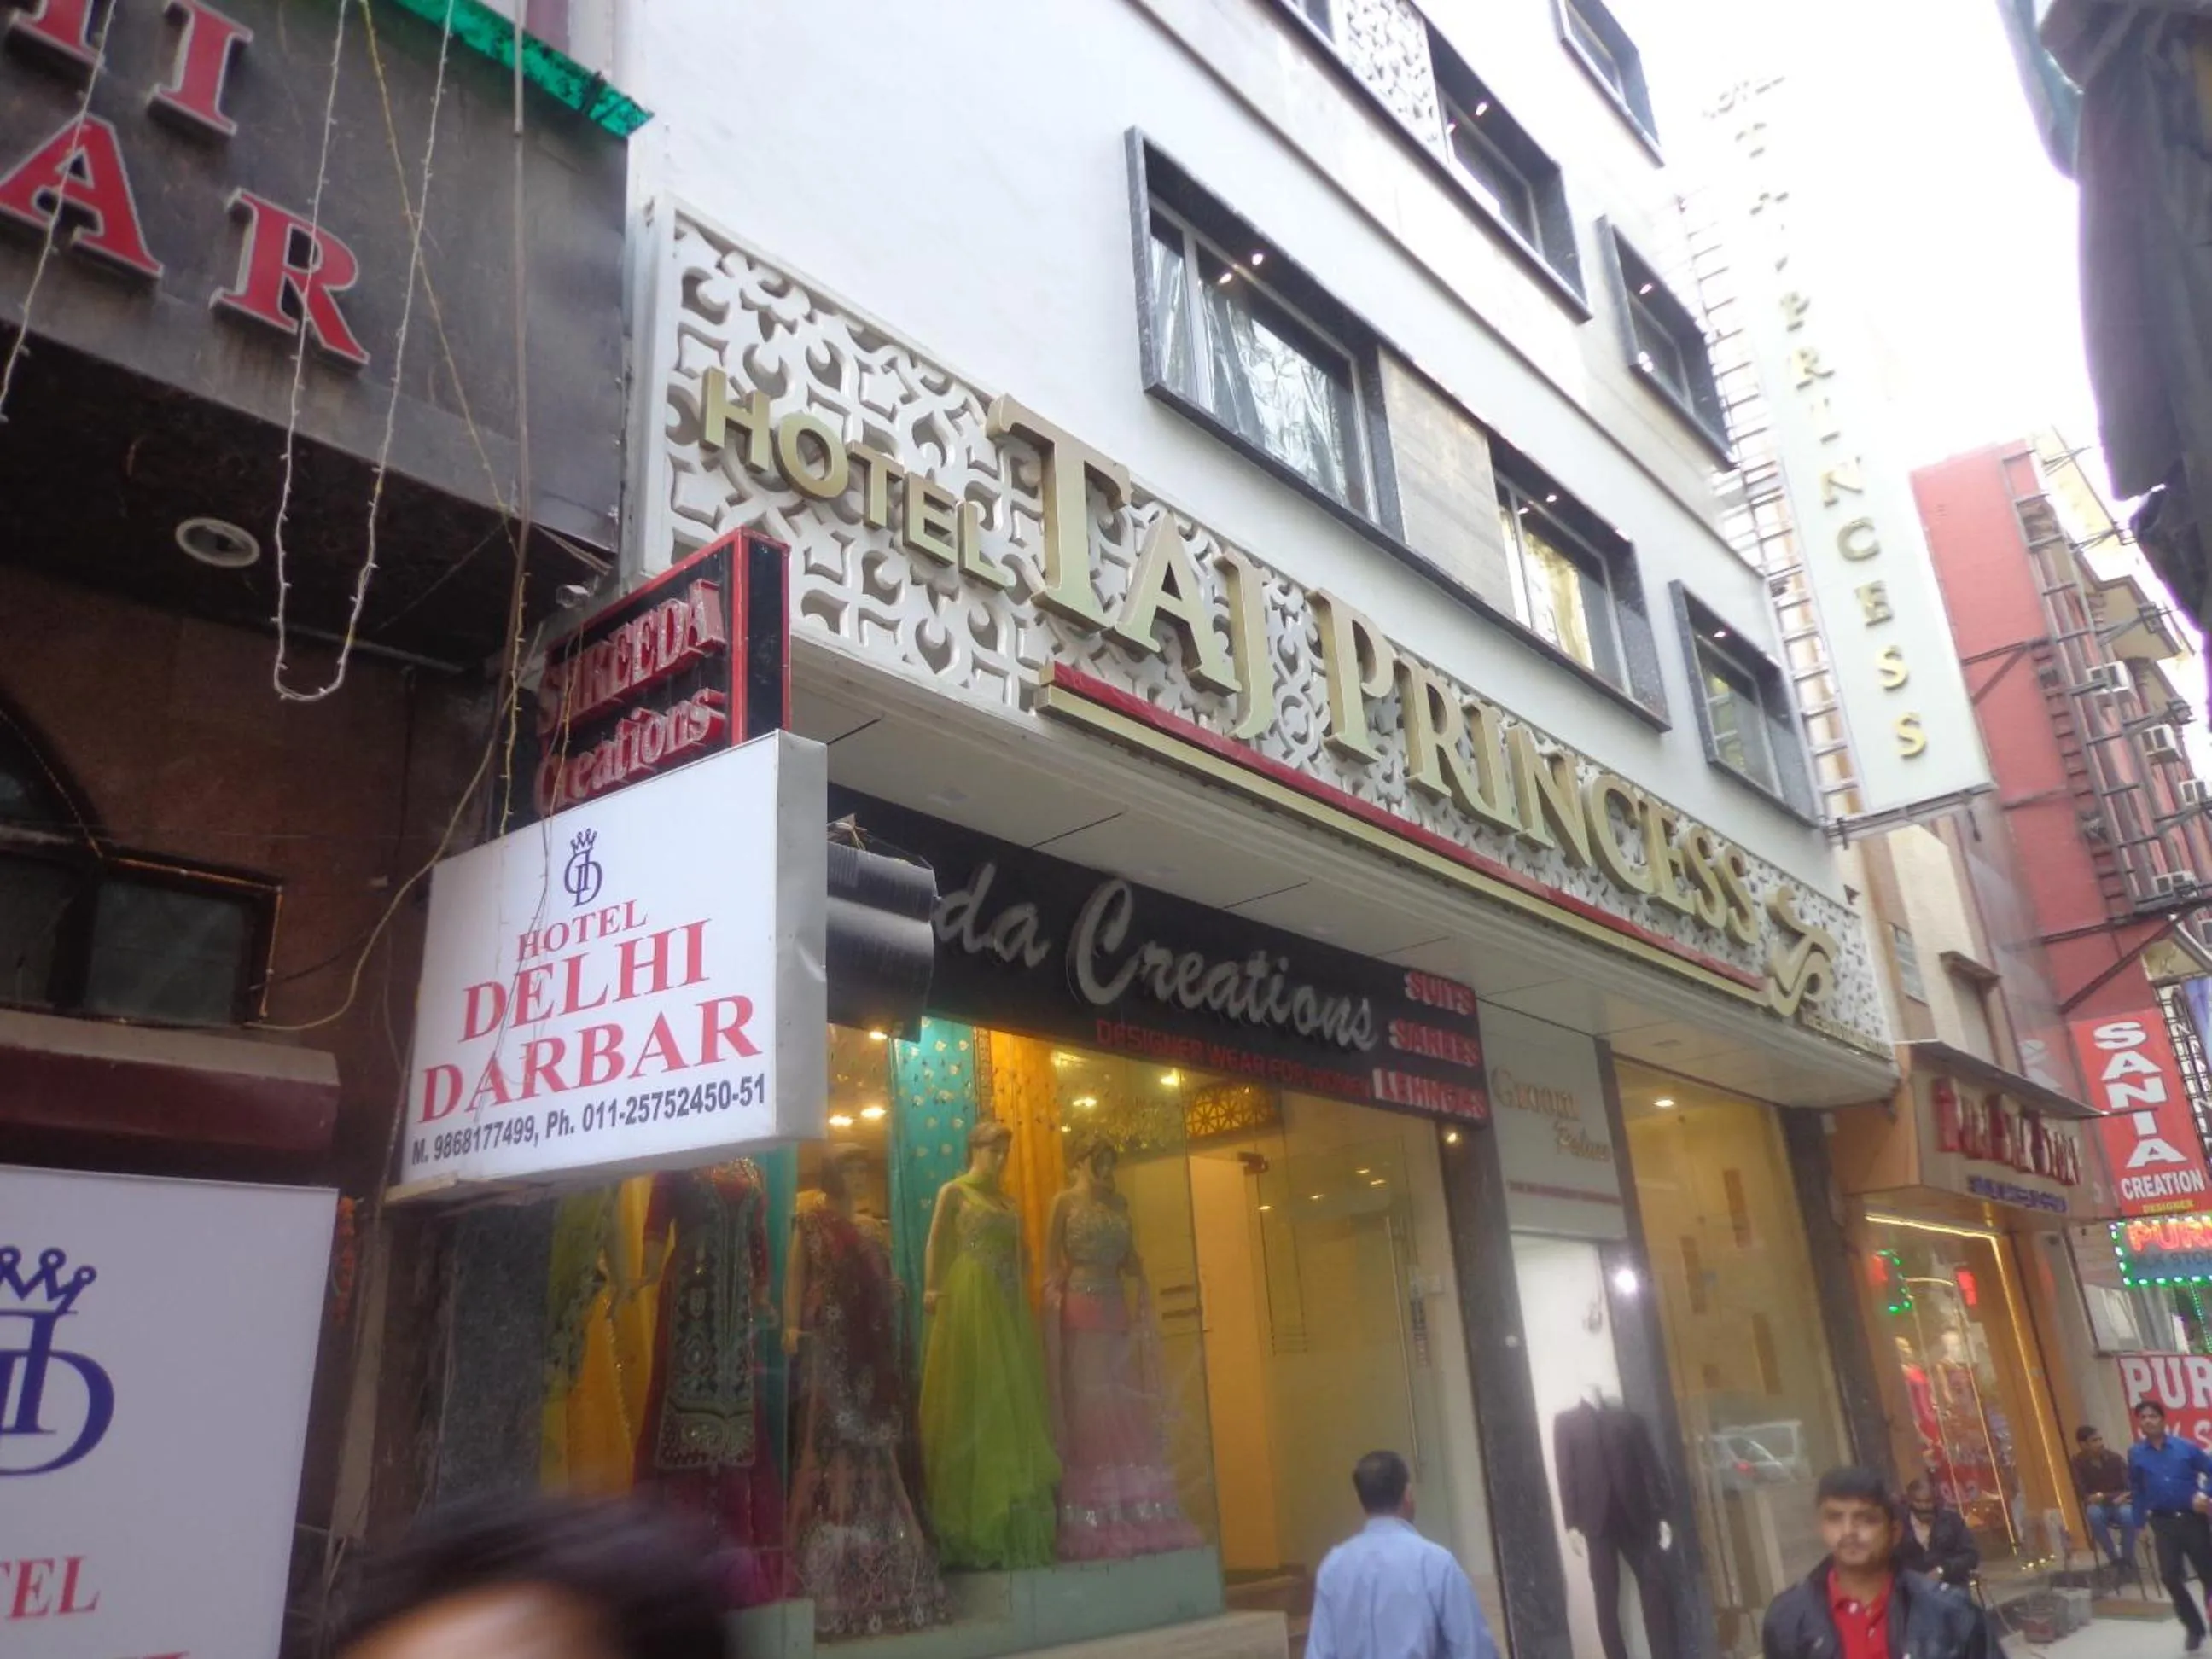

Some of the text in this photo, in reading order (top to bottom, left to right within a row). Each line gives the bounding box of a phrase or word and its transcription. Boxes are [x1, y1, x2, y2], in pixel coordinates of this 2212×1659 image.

[7, 0, 253, 137] I
[701, 366, 1759, 948] HOTEL TAJ PRINCESS
[536, 688, 727, 814] Creations
[457, 918, 713, 1043] DELHI
[516, 899, 648, 962] HOTEL
[1069, 879, 1377, 1051] Creations
[412, 1074, 765, 1166] M. 9868177499, Ph. 011-25752450-51
[416, 994, 762, 1123] DARBAR
[2093, 1022, 2188, 1169] SANIA
[2122, 1169, 2205, 1201] CREATION
